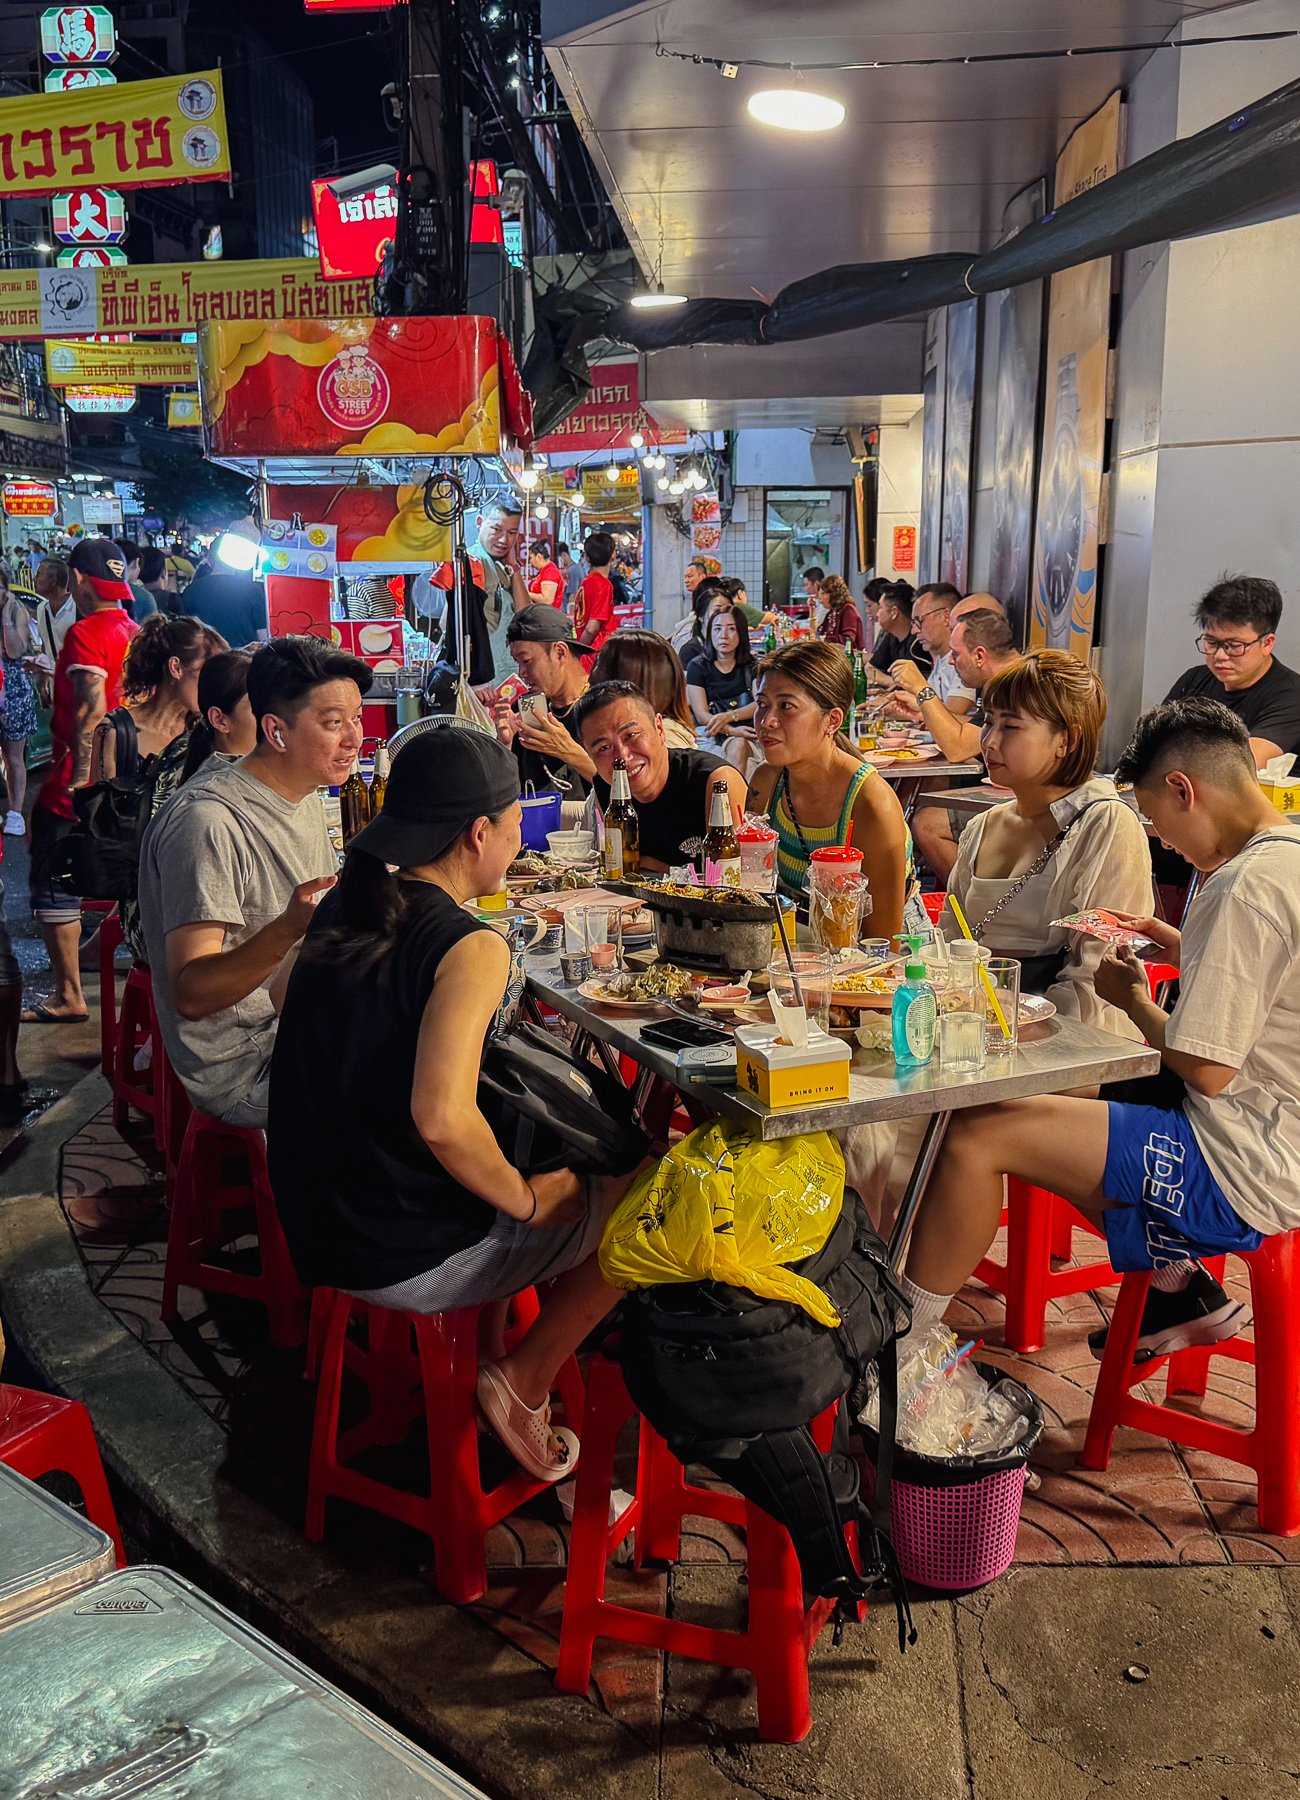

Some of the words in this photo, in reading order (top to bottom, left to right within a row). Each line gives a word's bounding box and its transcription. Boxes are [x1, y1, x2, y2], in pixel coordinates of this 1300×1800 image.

[74, 192, 108, 239] 大
[335, 381, 373, 398] GSB
[338, 400, 372, 409] STREET
[789, 1088, 813, 1097] BRING
